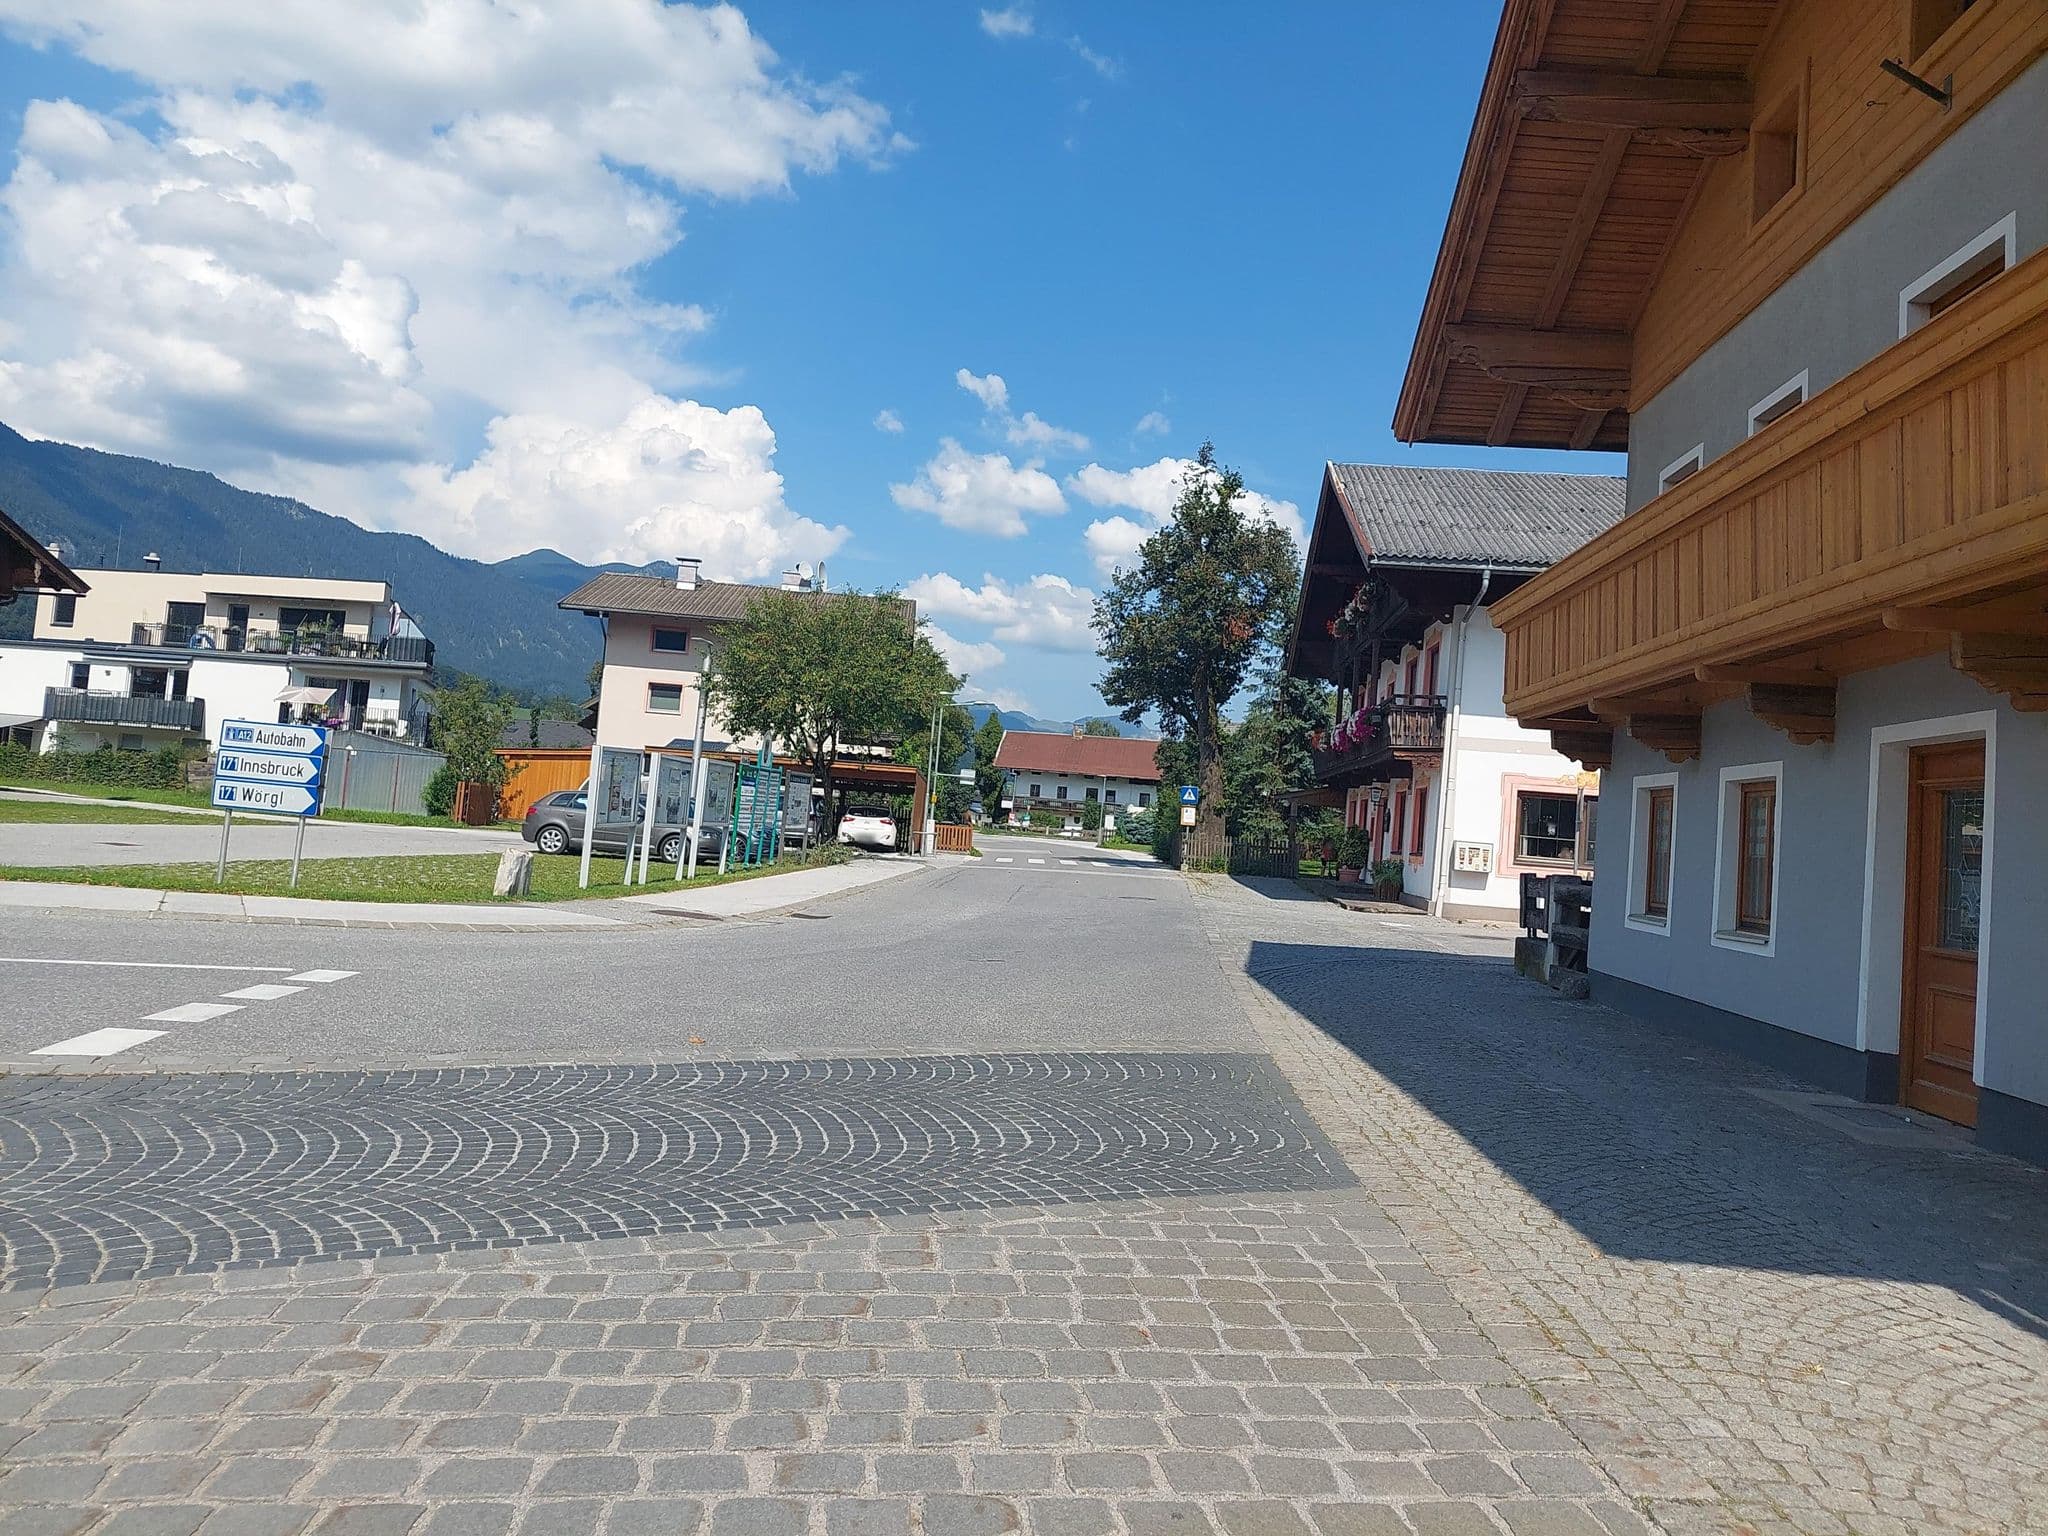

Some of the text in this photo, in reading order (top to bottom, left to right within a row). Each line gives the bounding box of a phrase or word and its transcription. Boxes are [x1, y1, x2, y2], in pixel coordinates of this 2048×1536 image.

[238, 729, 306, 748] A12 Autobahn
[222, 756, 305, 777] 171 Innsbruck
[220, 786, 284, 808] 171 Wörgl
